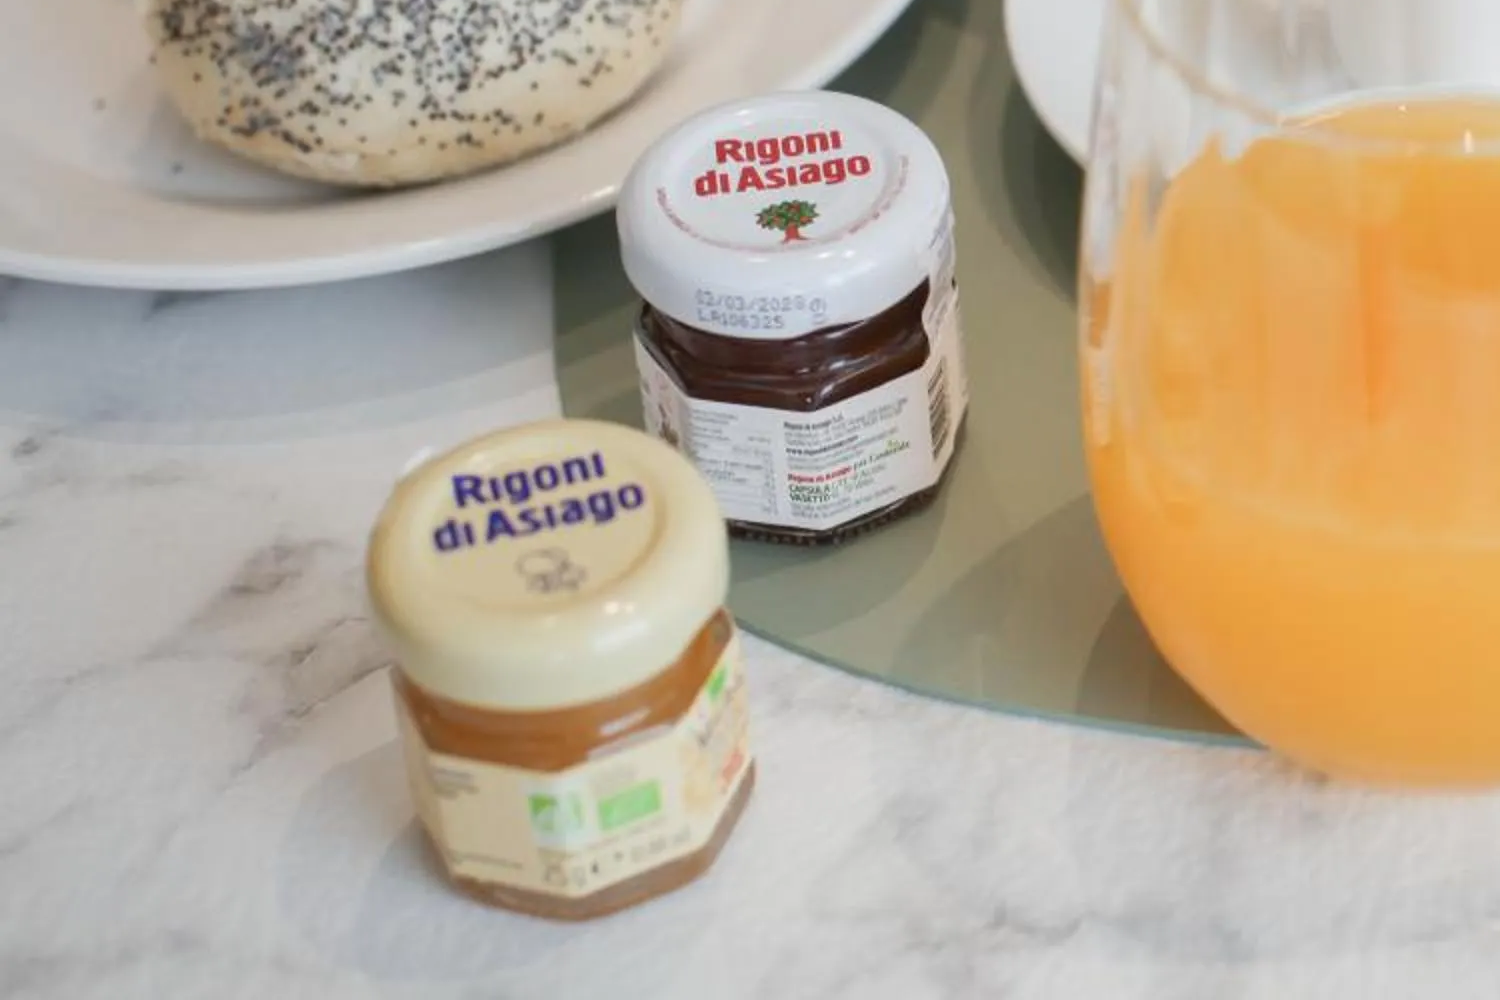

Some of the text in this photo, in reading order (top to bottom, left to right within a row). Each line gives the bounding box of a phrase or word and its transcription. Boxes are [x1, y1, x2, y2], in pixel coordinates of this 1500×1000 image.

[715, 130, 841, 165] Rigoni
[695, 155, 871, 197] di Asiago
[452, 452, 606, 508] Rigoni
[434, 484, 644, 552] di Asiago
